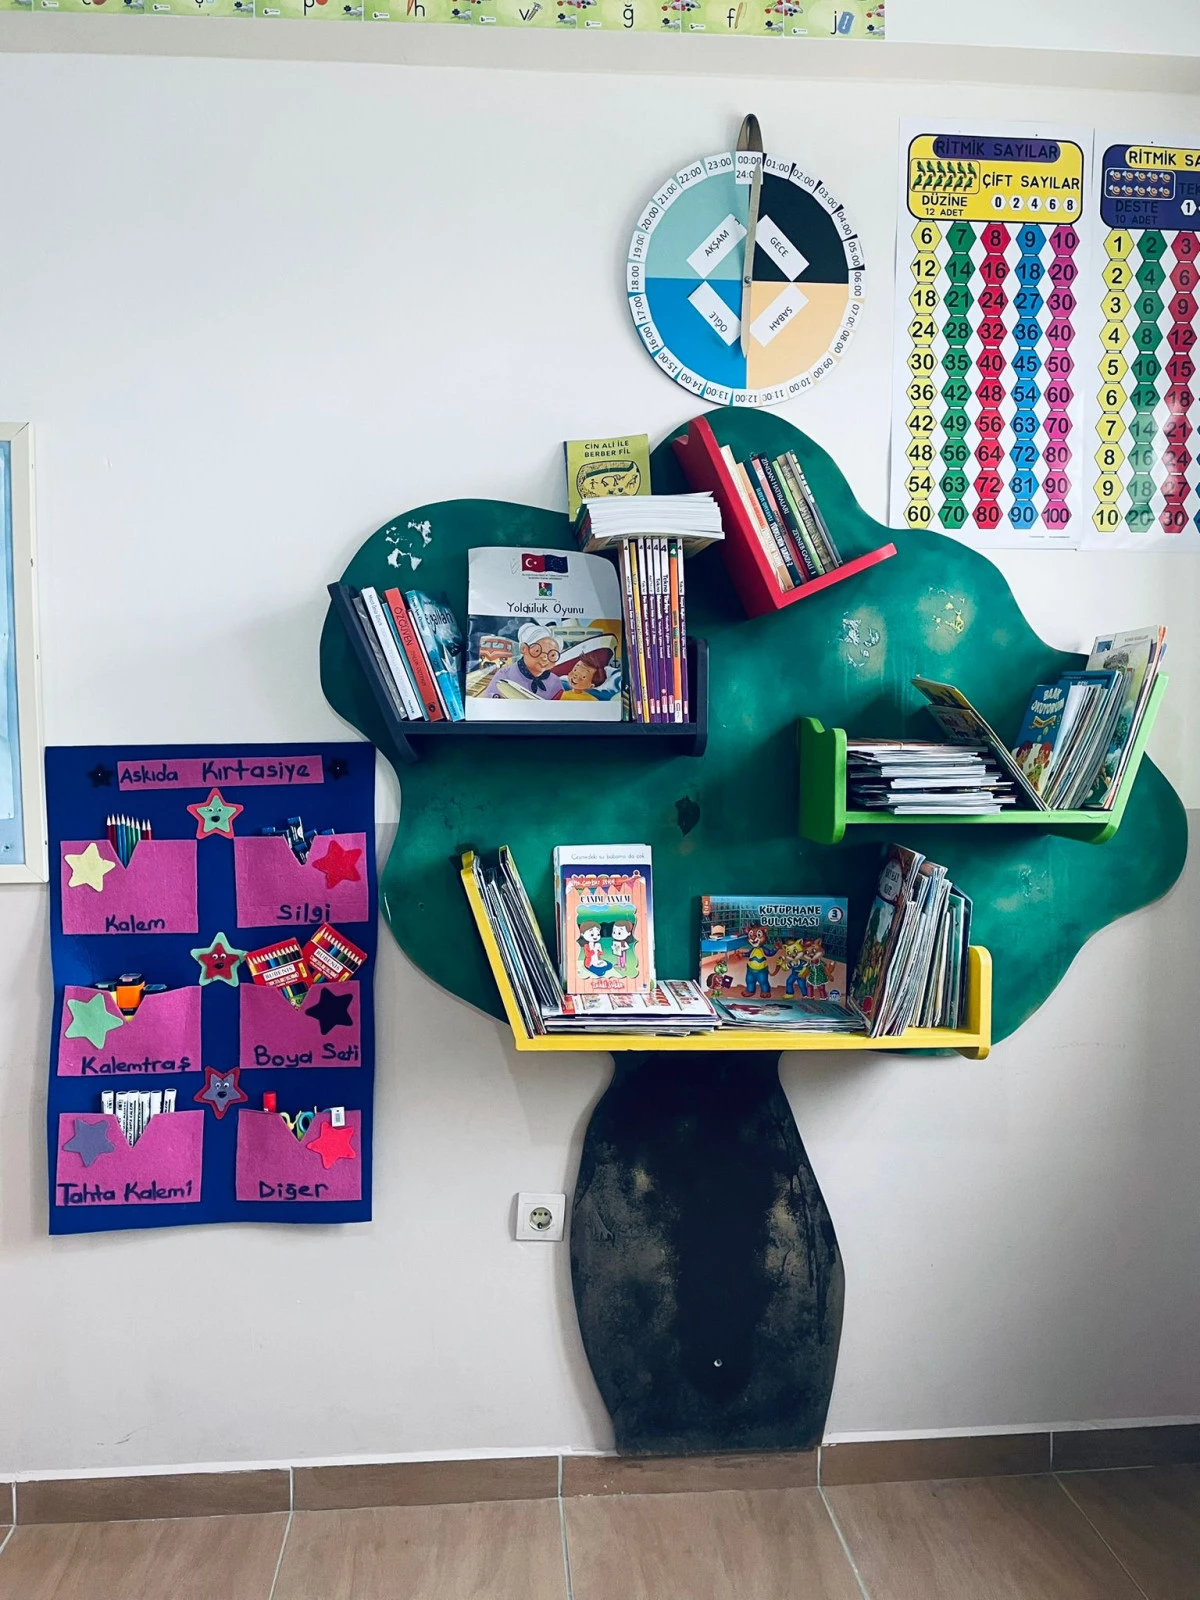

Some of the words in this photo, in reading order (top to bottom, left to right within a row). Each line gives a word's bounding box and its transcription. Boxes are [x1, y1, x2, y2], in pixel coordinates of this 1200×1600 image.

[623, 3, 634, 28] ğ
[727, 8, 735, 26] f
[830, 11, 837, 34] j
[936, 139, 984, 156] RİTMİK
[993, 143, 1058, 158] SAYILAR
[707, 157, 731, 170] 23:00
[737, 156, 762, 165] 00:00
[766, 160, 789, 173] 01:00
[1129, 150, 1176, 166] RİTMİK
[679, 166, 702, 184] 22:00
[792, 170, 815, 187] 02:00
[983, 172, 1012, 189] ÇİFT
[1021, 175, 1079, 190] SAYILAR
[658, 184, 677, 205] 21:00
[818, 187, 838, 209] 03:00
[922, 193, 968, 207] DÜZİNE
[994, 197, 1002, 208] 0
[1013, 197, 1020, 208] 2
[1031, 198, 1038, 209] 4
[1049, 199, 1056, 210] 6
[1067, 200, 1074, 210] 8
[939, 208, 963, 216] ADET
[1116, 200, 1158, 213] DESTE
[1186, 202, 1190, 213] 1
[642, 207, 659, 230] 20:00
[837, 211, 852, 236] 04:00
[1116, 214, 1126, 224] 10
[1132, 215, 1158, 224] ADET
[634, 234, 645, 258] 19:00
[704, 230, 730, 258] AKŞAM
[770, 237, 789, 257] GECE
[922, 228, 932, 244] 6
[957, 230, 966, 245] 7
[990, 230, 1000, 246] 8
[1025, 232, 1035, 247] 9
[1054, 232, 1075, 248] 10
[1114, 236, 1121, 252] 1
[1146, 238, 1157, 253] 2
[1181, 238, 1191, 254] 3
[848, 241, 860, 267] 05:00
[631, 266, 639, 290] 18:00
[914, 260, 935, 276] 12
[949, 261, 971, 278] 14
[984, 262, 1006, 278] 16
[1018, 263, 1040, 279] 18
[1052, 264, 1074, 280] 20
[1112, 268, 1122, 283] 2
[1144, 268, 1155, 284] 4
[1179, 270, 1189, 285] 6
[634, 296, 646, 320] 17:00
[914, 290, 936, 306] 18
[948, 291, 968, 308] 21
[982, 292, 1004, 308] 24
[1016, 293, 1039, 309] 27
[1050, 294, 1072, 310] 30
[1111, 297, 1120, 313] 3
[1143, 298, 1153, 314] 6
[1178, 299, 1188, 315] 9
[710, 311, 728, 332] ÖĞLE
[770, 306, 793, 332] SABAH
[643, 326, 659, 350] 16:00
[912, 322, 935, 338] 24
[946, 322, 968, 338] 28
[981, 323, 1003, 340] 32
[1016, 324, 1038, 340] 36
[1048, 325, 1071, 341] 40
[1108, 328, 1120, 343] 4
[1142, 329, 1152, 344] 8
[1171, 330, 1194, 346] 12
[834, 330, 850, 354] 08:00
[658, 352, 678, 372] 15:00
[814, 357, 833, 378] 09:00
[912, 354, 934, 370] 30
[946, 354, 968, 370] 35
[980, 355, 1002, 371] 40
[1014, 356, 1036, 372] 45
[1048, 357, 1070, 372] 50
[1108, 360, 1118, 375] 5
[1135, 358, 1158, 376] 10
[1170, 360, 1192, 376] 15
[680, 373, 702, 391] 14:00
[789, 377, 811, 393] 10:00
[706, 387, 728, 399] 13:00
[735, 394, 758, 402] 12:00
[911, 384, 933, 400] 36
[944, 385, 968, 401] 42
[979, 386, 1001, 401] 48
[1014, 386, 1036, 402] 54
[1048, 387, 1069, 402] 60
[1106, 390, 1116, 405] 6
[1133, 390, 1156, 406] 12
[1170, 391, 1190, 406] 18
[910, 415, 933, 431] 42
[944, 416, 966, 431] 49
[979, 416, 1001, 432] 56
[1013, 417, 1035, 432] 63
[1046, 418, 1068, 433] 70
[1106, 420, 1116, 436] 7
[1166, 423, 1188, 438] 21
[585, 449, 616, 458] BERBER
[909, 445, 932, 460] 48
[944, 445, 966, 461] 56
[978, 446, 1001, 461] 64
[1013, 446, 1034, 462] 72
[1046, 447, 1067, 462] 80
[1104, 450, 1114, 465] 8
[762, 458, 774, 482] ZİNDAN
[771, 479, 789, 514] HATIRALARI
[909, 476, 931, 492] 54
[943, 477, 965, 492] 63
[978, 477, 1000, 492] 72
[1012, 477, 1032, 493] 81
[1046, 478, 1067, 493] 90
[1103, 480, 1113, 496] 9
[908, 506, 930, 522] 60
[942, 506, 964, 522] 70
[977, 506, 999, 522] 80
[1010, 507, 1033, 522] 90
[1043, 508, 1069, 523] 100
[1097, 510, 1118, 525] 10
[120, 764, 178, 784] Askıda
[202, 760, 311, 782] Kırtasiye
[276, 904, 331, 923] Silgi
[760, 905, 821, 915] KÜTÜPHANE
[832, 909, 837, 918] 3
[105, 915, 165, 932] Kalem
[761, 916, 819, 928] BULUŞMASI
[81, 1056, 191, 1075] Kalemtraş
[254, 1045, 313, 1068] Boya
[58, 1182, 115, 1206] Tahta
[124, 1180, 192, 1200] Kalemi
[259, 1181, 329, 1199] Diğer
